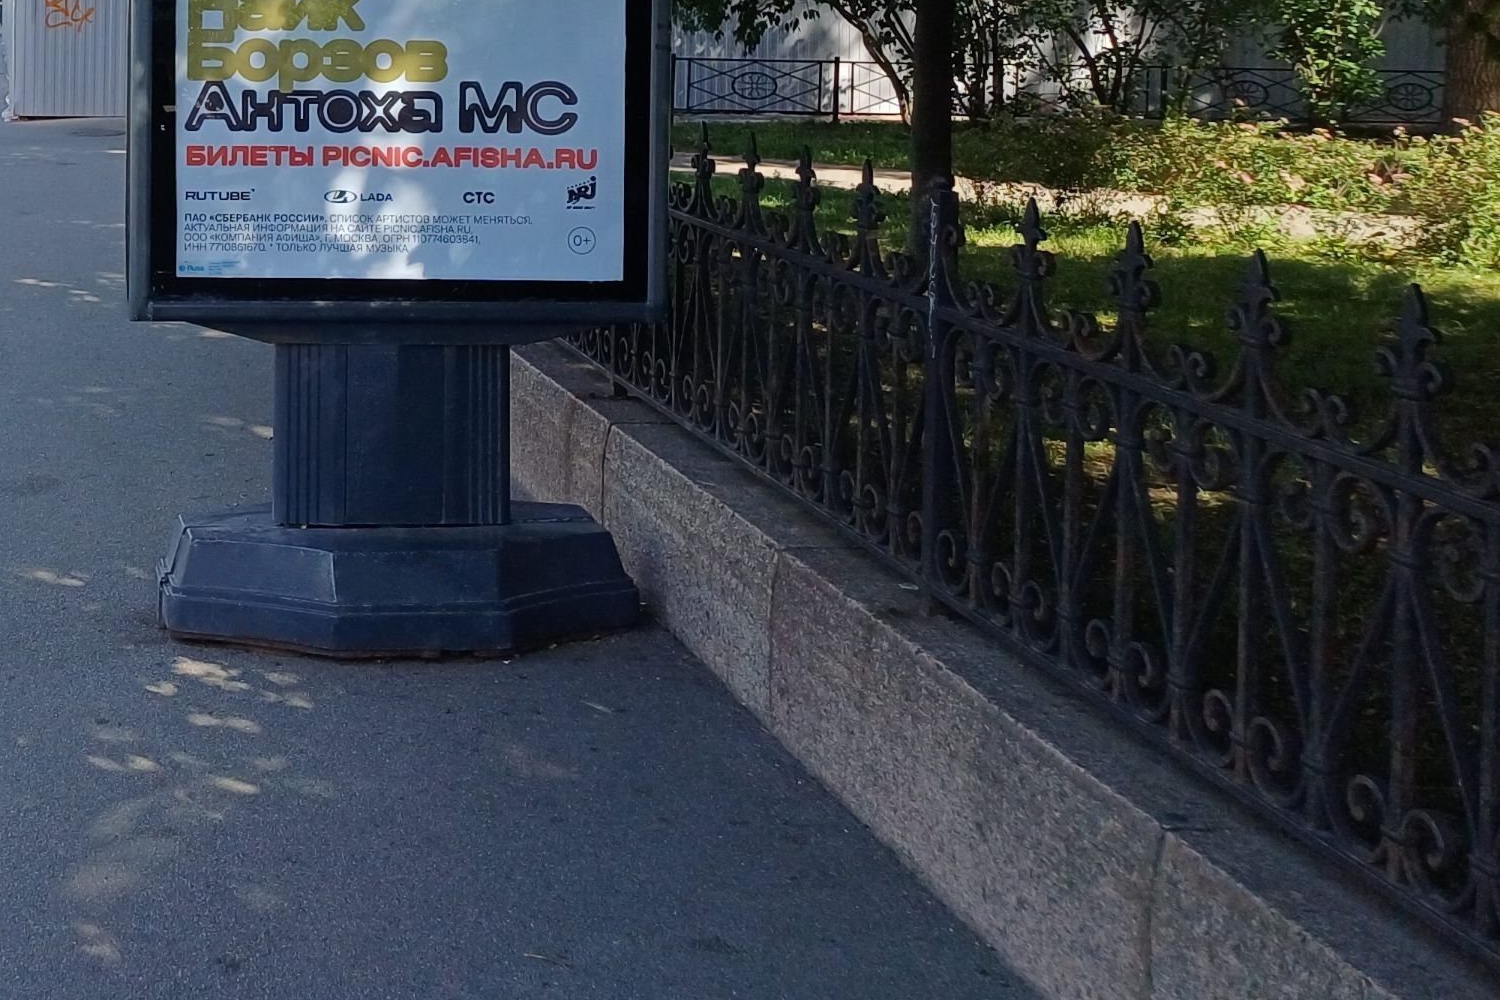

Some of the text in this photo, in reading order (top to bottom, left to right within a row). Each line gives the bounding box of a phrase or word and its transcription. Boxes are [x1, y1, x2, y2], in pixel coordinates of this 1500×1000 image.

[187, 30, 449, 93] Борзов
[185, 81, 444, 134] Антоха
[185, 145, 598, 170] БИЛЕТЫ PICNIC.AFISHA.RU
[185, 190, 252, 201] RUTUBE
[360, 192, 394, 203] LADA
[184, 213, 207, 223] ПАО
[209, 213, 272, 223] «СБЕРБАНК
[329, 214, 373, 224] СПИСОК
[377, 215, 431, 225] АРТИСТОВ
[433, 215, 471, 225] МОЖЕТ
[184, 223, 250, 233] АКТУАЛЬНАЯ
[252, 223, 328, 234] ИНФОРМАЦИЯ
[330, 224, 345, 233] НА
[347, 223, 382, 234] САЙТЕ
[184, 233, 208, 242] ООО
[209, 233, 274, 243] «КОМПАНИЯ
[382, 234, 409, 244] ОГРН
[573, 234, 592, 247] 0+
[184, 243, 207, 253] ИНН
[276, 243, 317, 253] ТОЛЬКО
[319, 243, 363, 254] ЛУЧШАЯ
